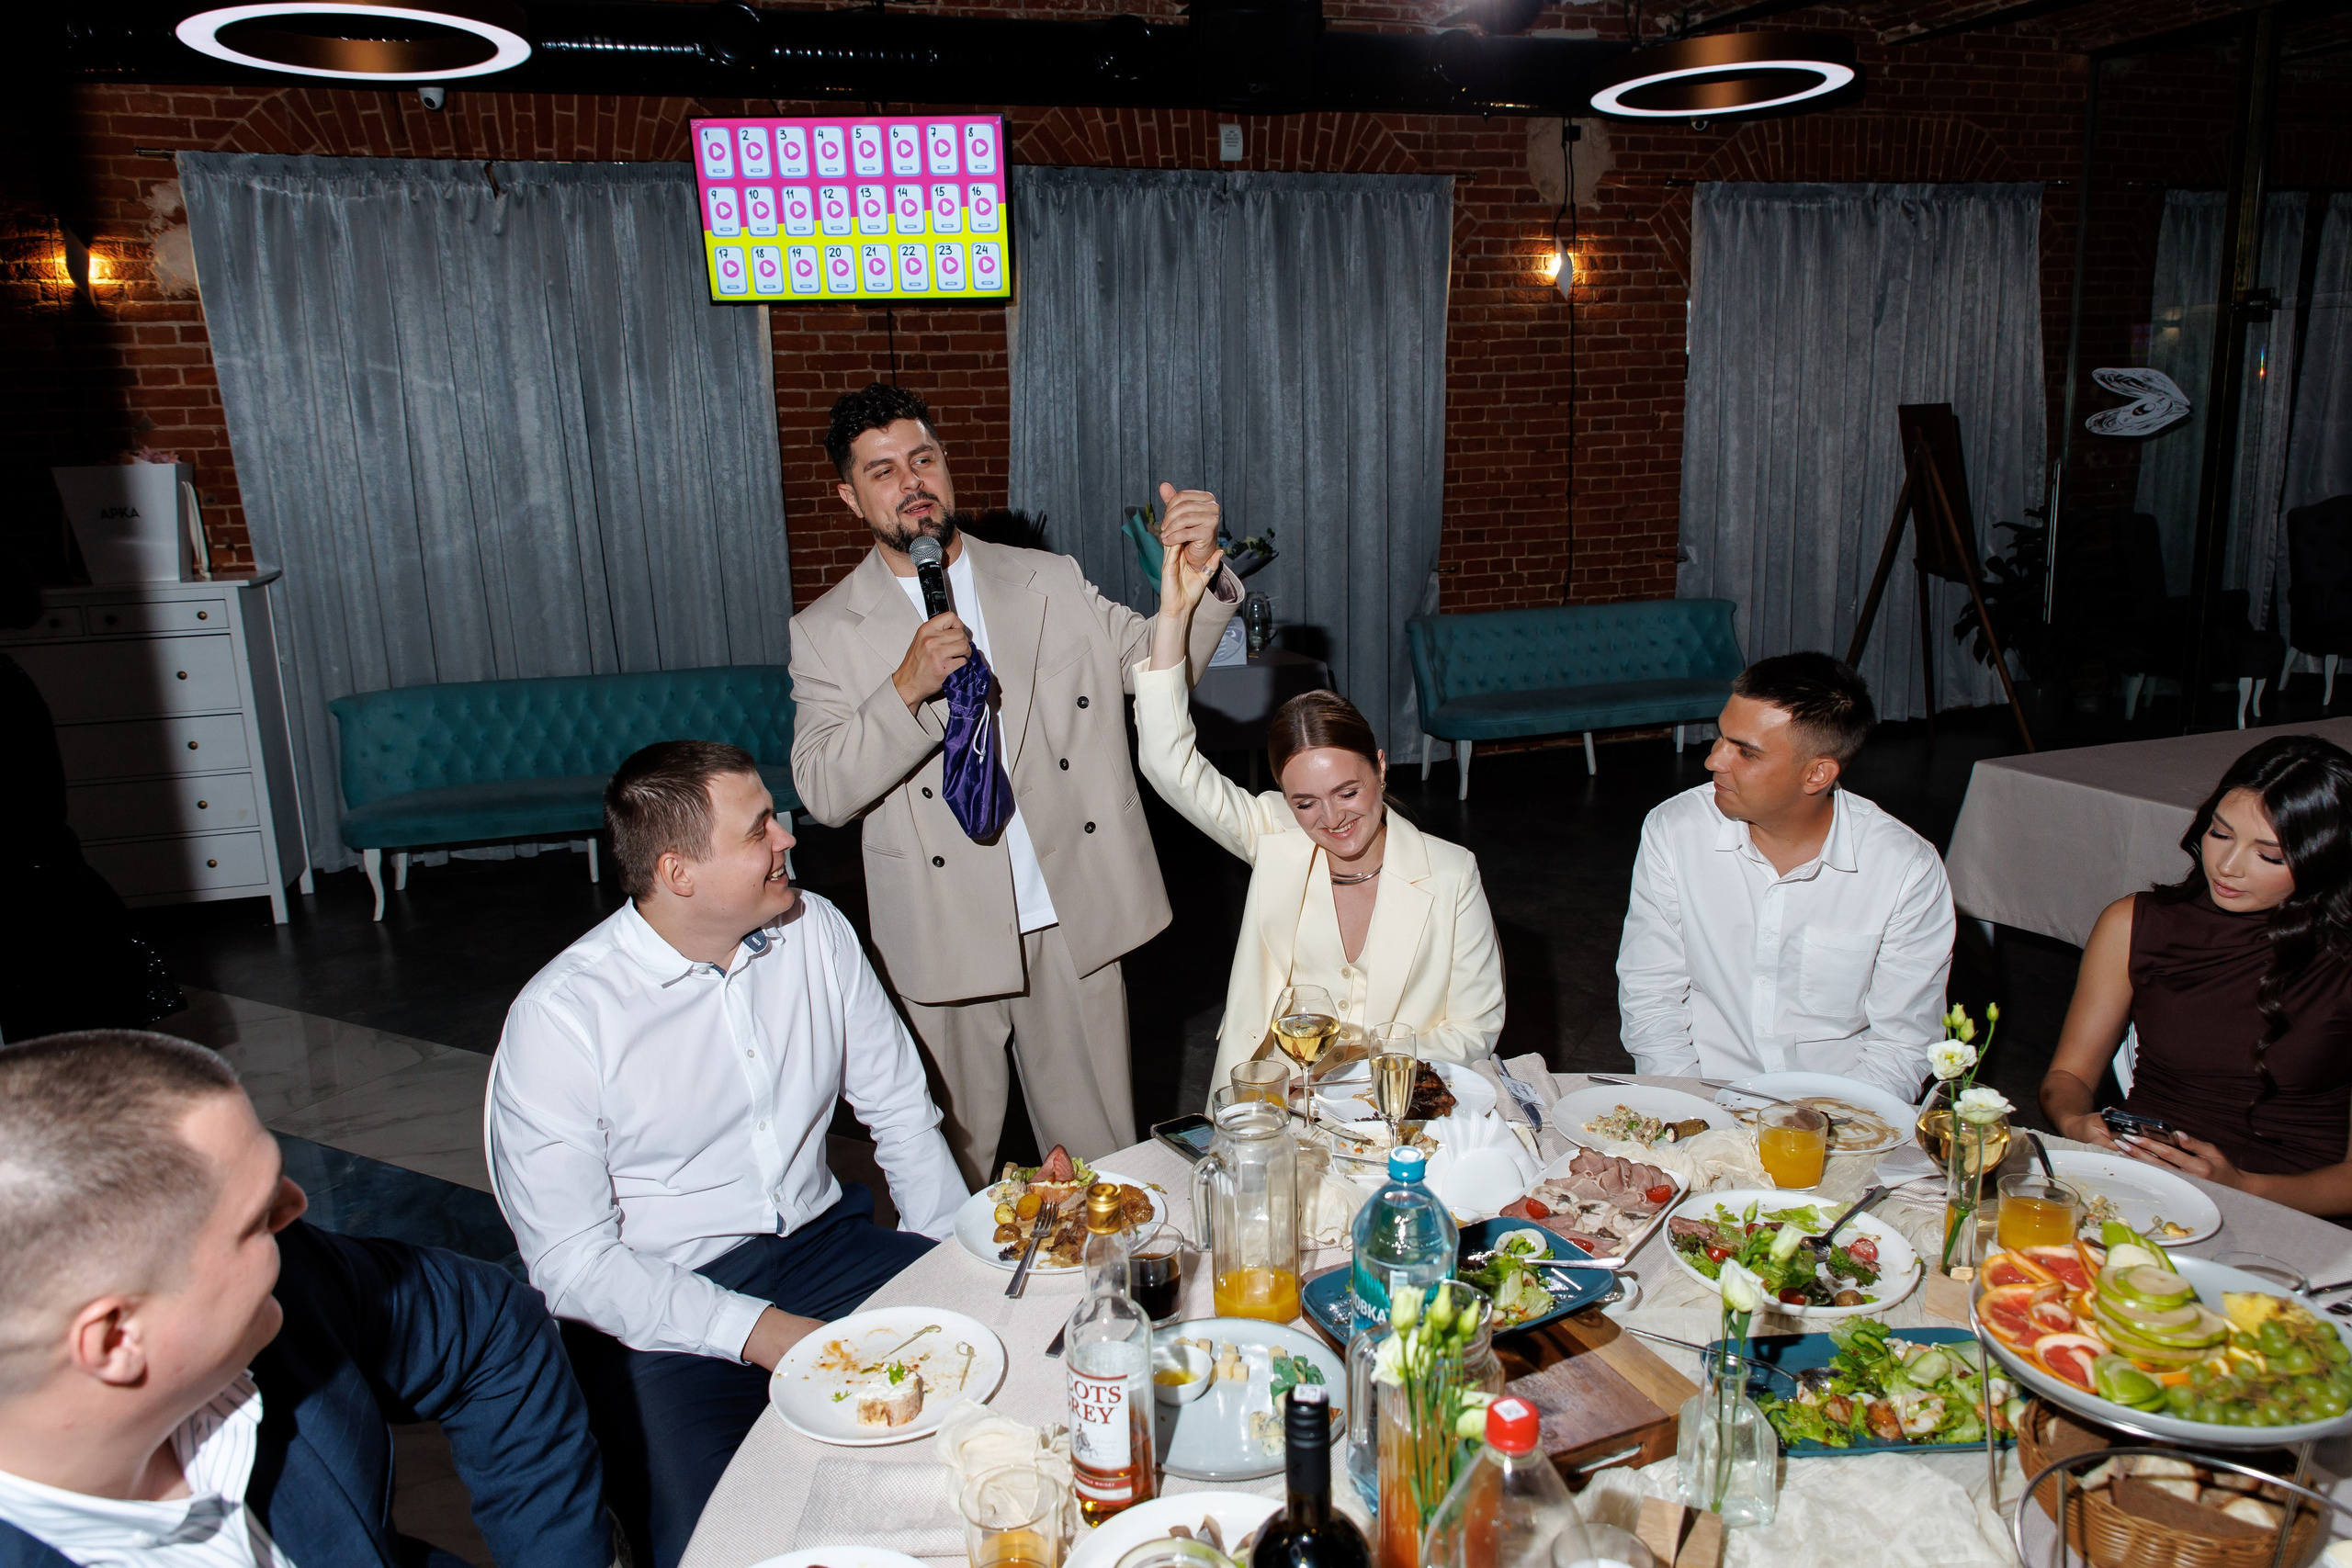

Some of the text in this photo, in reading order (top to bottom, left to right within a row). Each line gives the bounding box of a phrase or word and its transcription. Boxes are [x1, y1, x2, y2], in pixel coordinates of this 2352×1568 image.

[704, 130, 708, 141] 1
[741, 130, 749, 141] 2
[780, 130, 787, 140] 3
[818, 129, 824, 139] 4
[855, 128, 862, 139] 5
[893, 128, 899, 138] 6
[930, 127, 936, 137] 7
[967, 127, 974, 137] 8
[711, 189, 717, 199] 9
[749, 189, 759, 199] 10
[786, 189, 794, 198] 11
[823, 188, 834, 198] 12
[860, 187, 872, 197] 13
[897, 187, 908, 197] 14
[934, 186, 945, 197] 15
[972, 186, 981, 196] 16
[718, 249, 729, 258] 17
[755, 249, 764, 258] 18
[792, 248, 801, 257] 19
[829, 247, 842, 257] 20
[865, 246, 876, 256] 21
[902, 246, 916, 255] 22
[939, 245, 953, 254] 23
[976, 244, 989, 254] 24
[1352, 1293, 1386, 1325] ОВКА
[1068, 1394, 1114, 1425] REY
